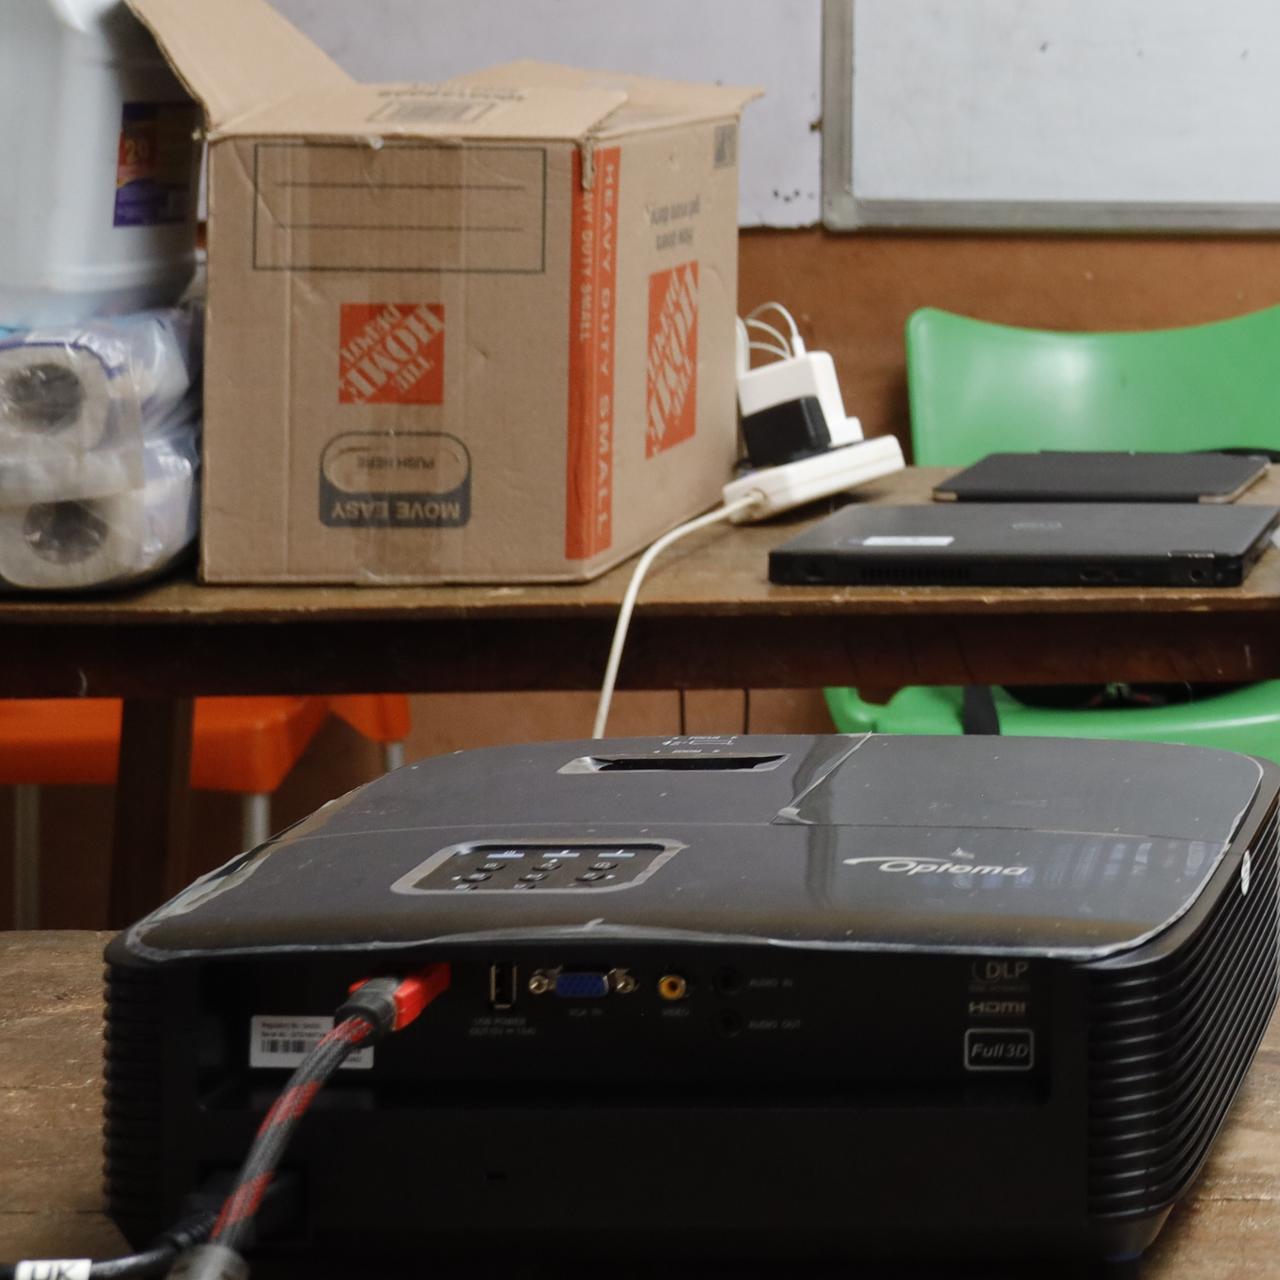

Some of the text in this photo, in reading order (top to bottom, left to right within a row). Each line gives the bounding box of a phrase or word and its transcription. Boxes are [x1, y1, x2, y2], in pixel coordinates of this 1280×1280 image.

[580, 228, 594, 276] DUTY
[339, 304, 401, 366] DEPOT
[579, 282, 593, 343] SMALL
[339, 303, 445, 406] HOME
[595, 162, 615, 538] HEAVY DUTY SMALL
[396, 455, 436, 471] PUSH
[331, 500, 462, 520] MOVE EASY
[877, 859, 1030, 876] Optoma
[986, 960, 1031, 979] DLP
